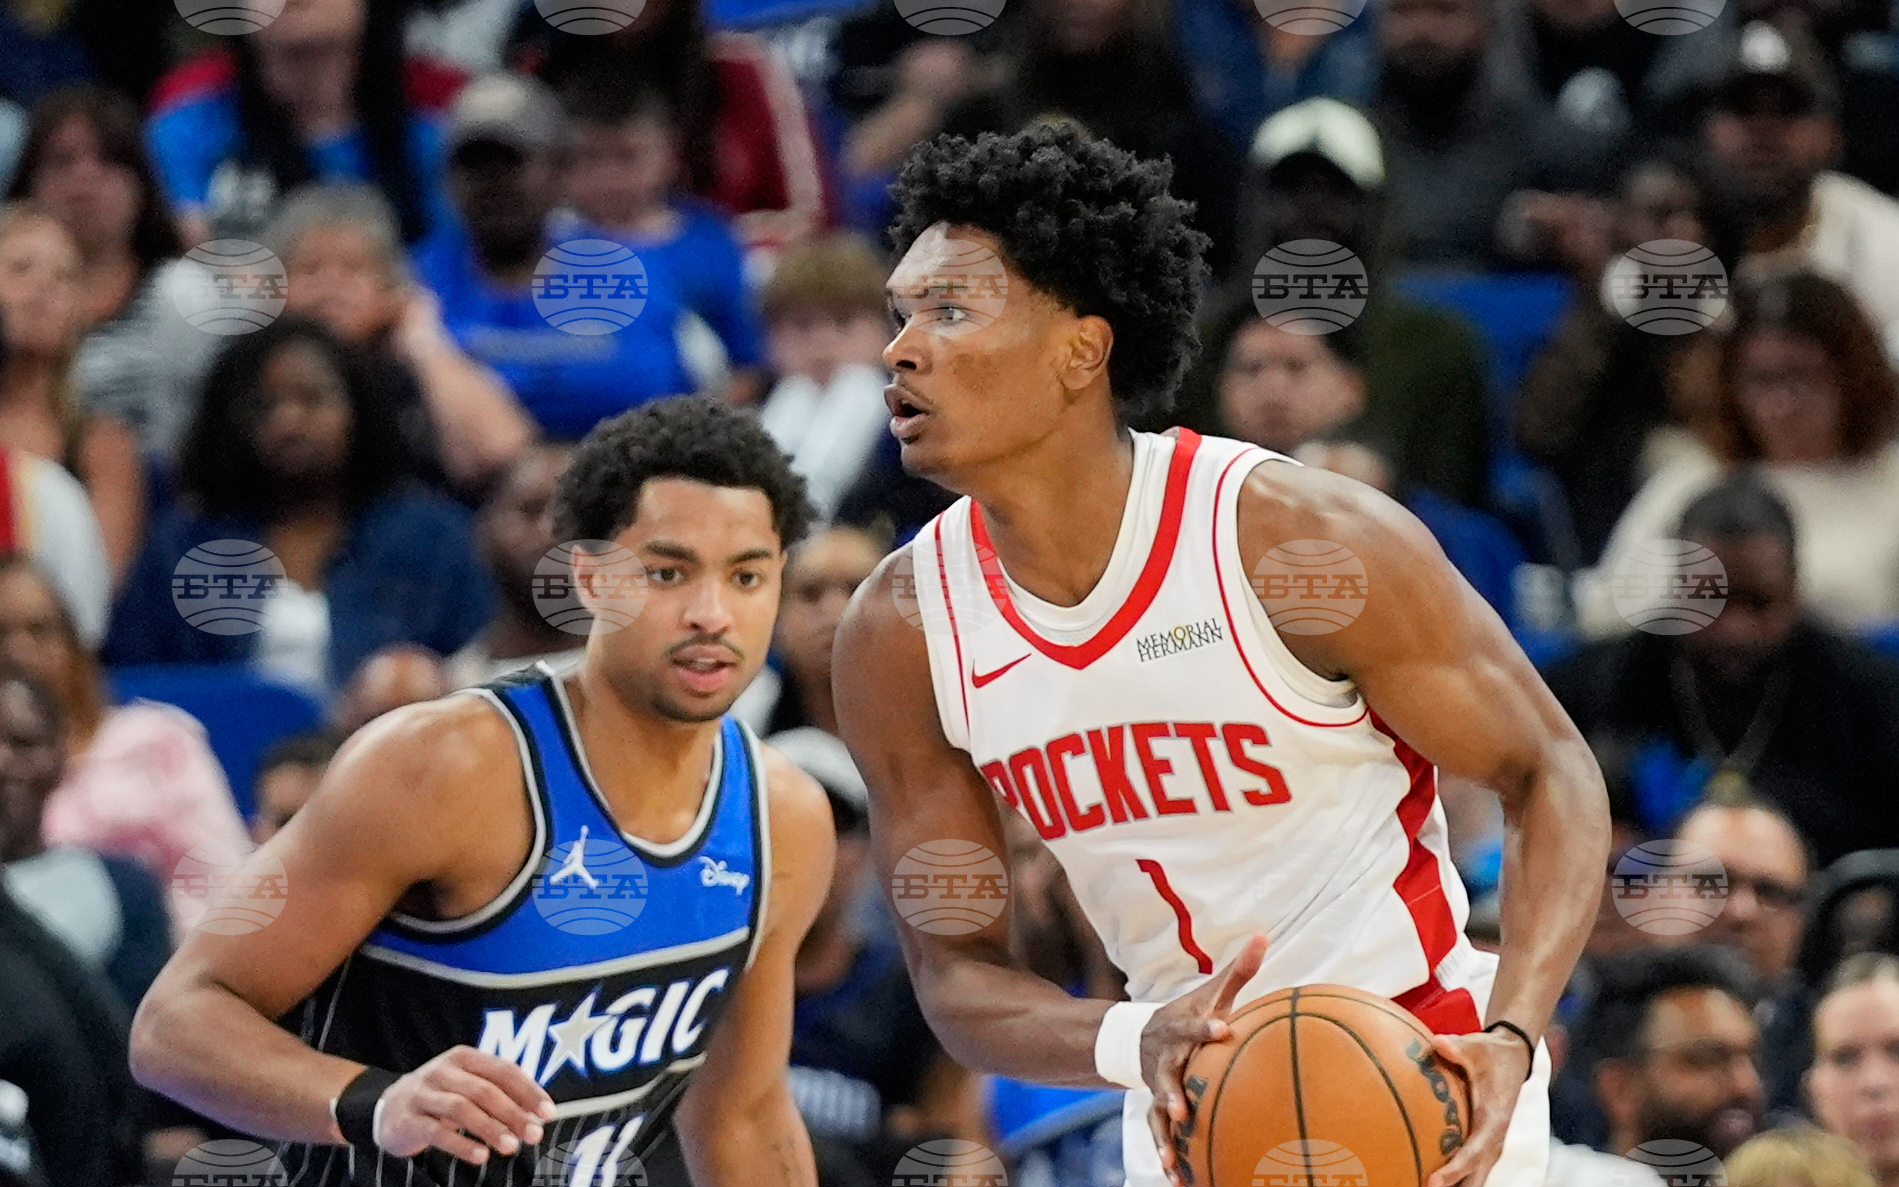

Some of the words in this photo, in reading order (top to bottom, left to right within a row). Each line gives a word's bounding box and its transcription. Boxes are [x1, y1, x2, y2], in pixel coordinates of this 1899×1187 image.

[1136, 617, 1221, 651] MEMORIAL
[1138, 626, 1223, 662] HERMANN
[699, 855, 751, 896] Disney
[1135, 858, 1213, 975] 1
